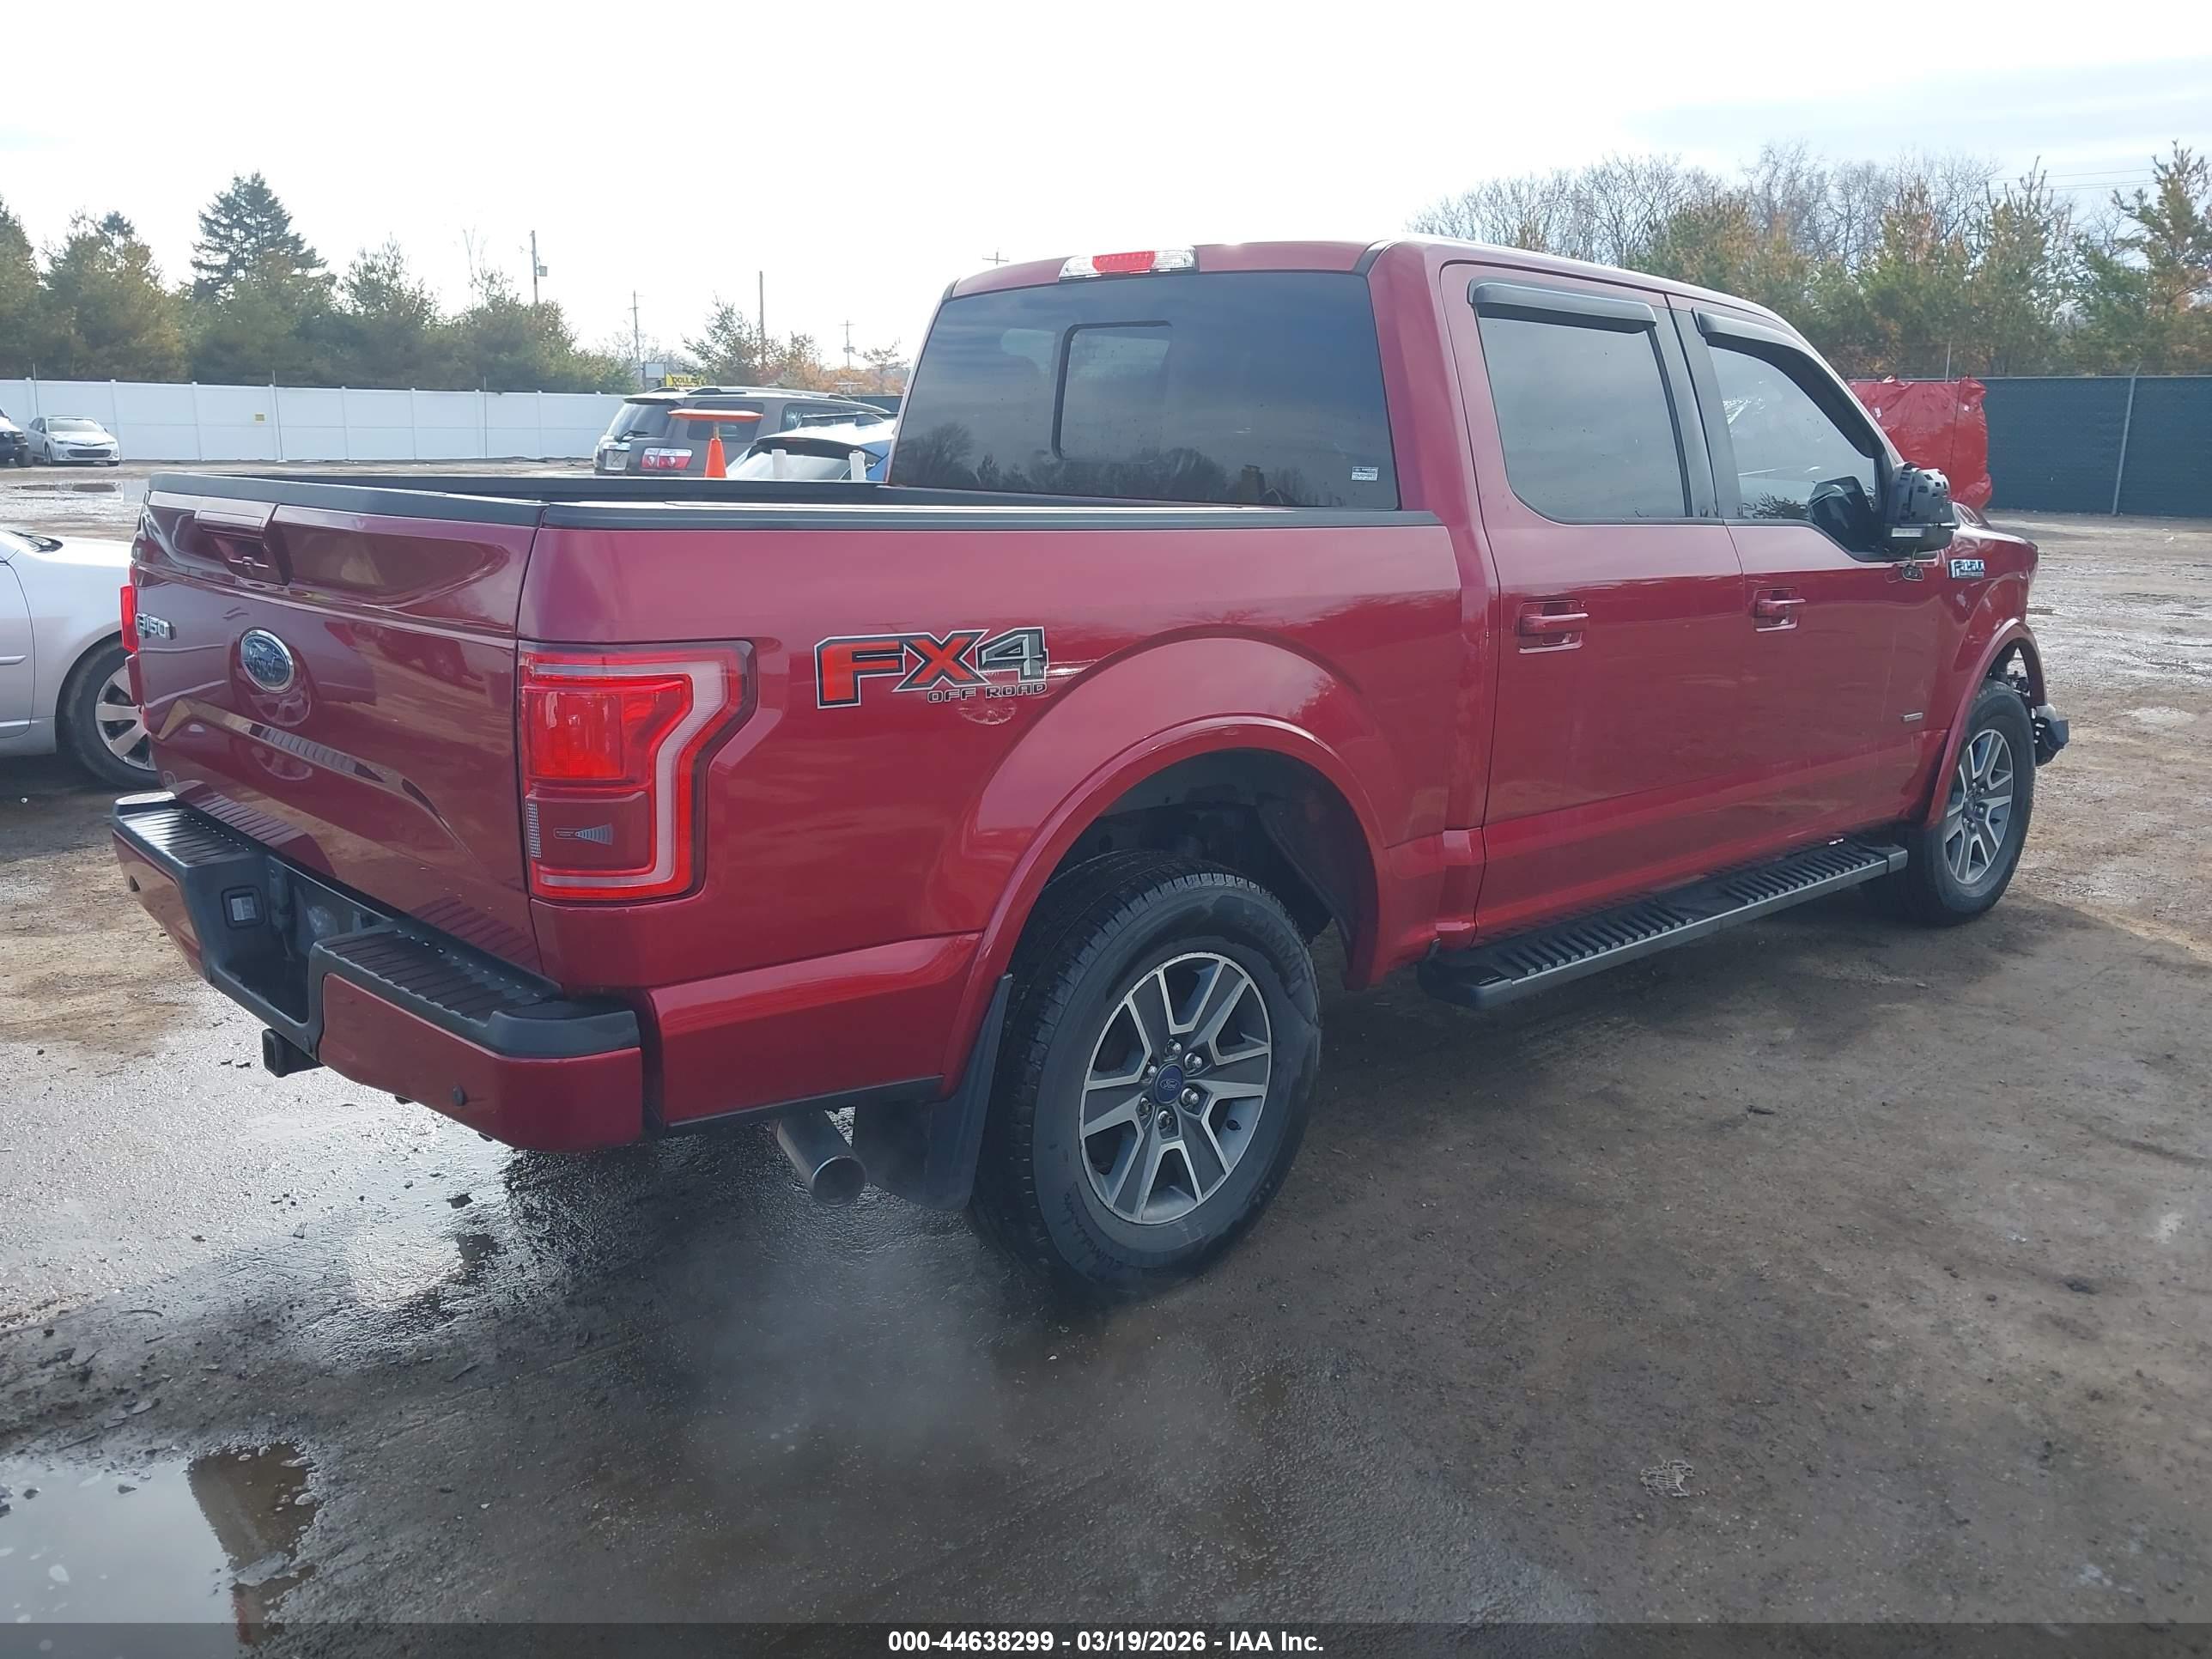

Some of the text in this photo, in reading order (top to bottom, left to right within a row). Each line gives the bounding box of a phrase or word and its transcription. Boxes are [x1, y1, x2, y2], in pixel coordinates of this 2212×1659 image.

[814, 626, 1049, 709] FX4
[927, 683, 1048, 703] OFF ROAD
